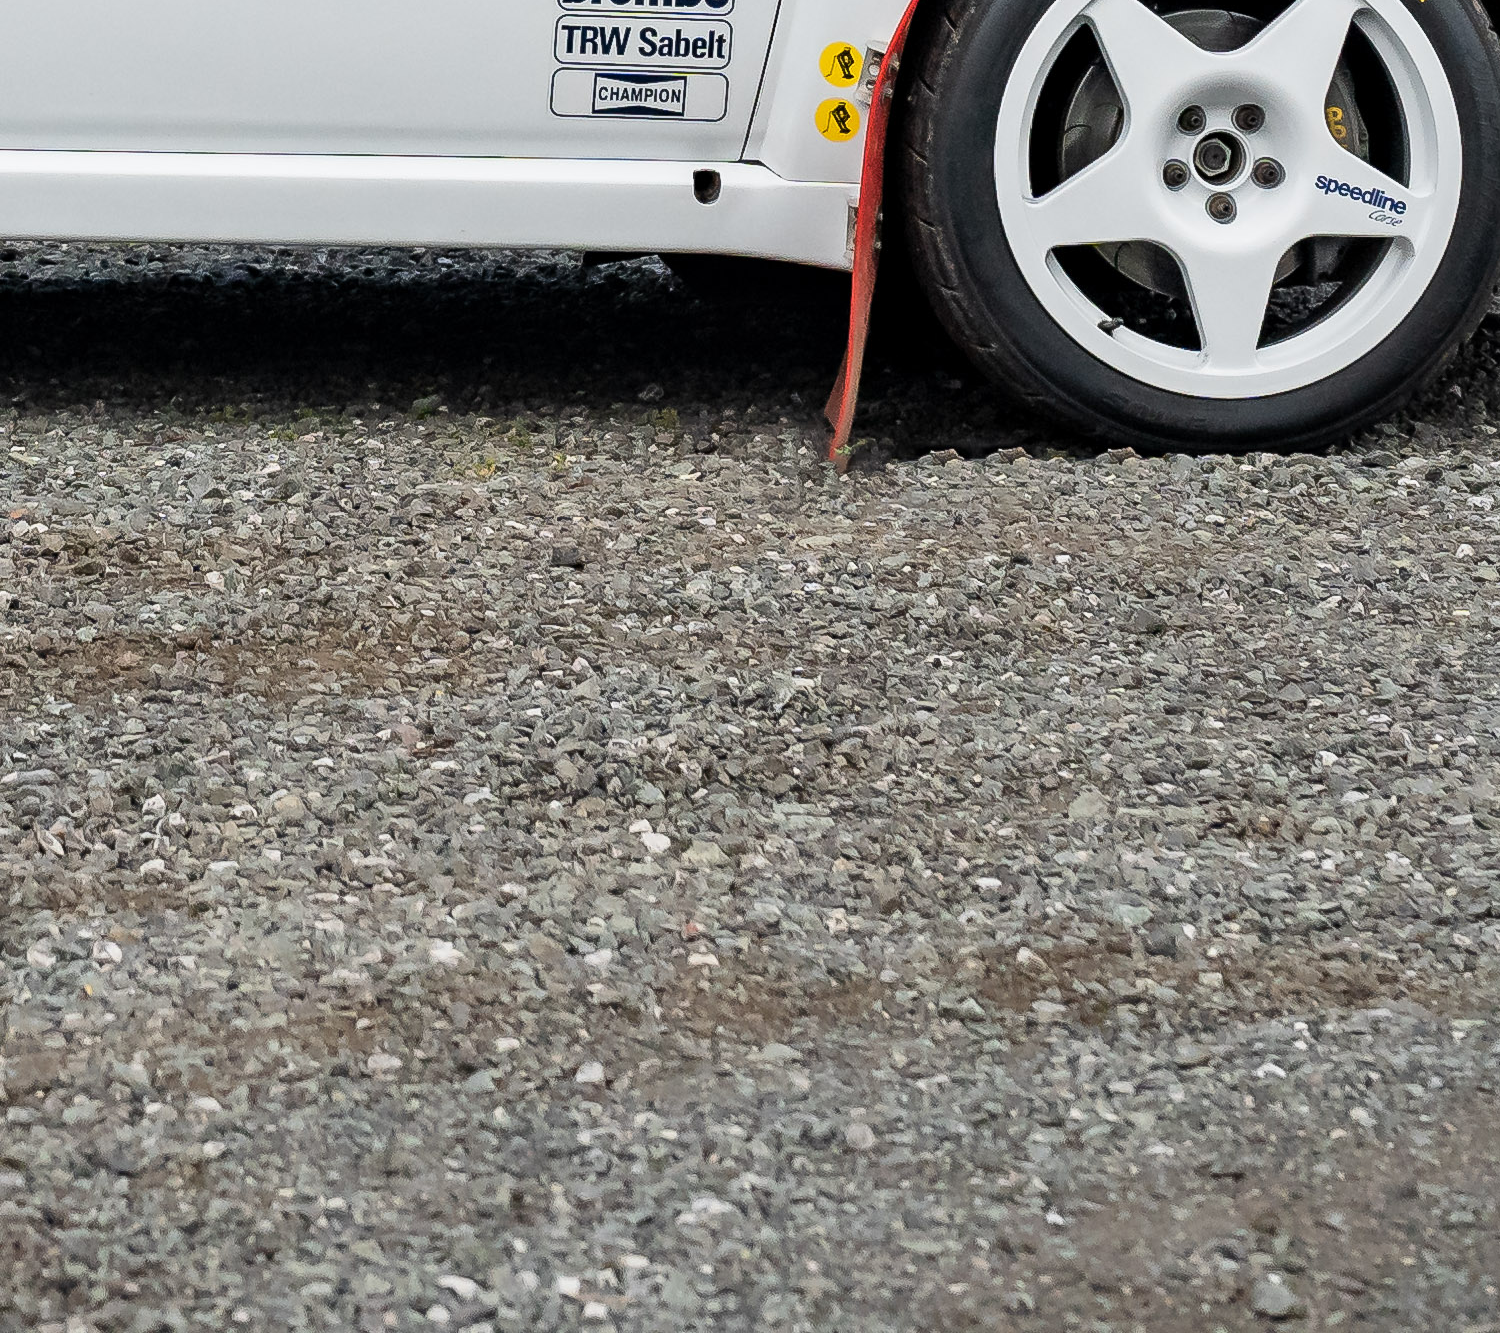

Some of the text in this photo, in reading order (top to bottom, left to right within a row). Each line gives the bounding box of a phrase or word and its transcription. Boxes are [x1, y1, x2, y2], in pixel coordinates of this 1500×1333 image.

[562, 25, 727, 60] TRW Sabelt
[599, 86, 682, 103] CHAMPION
[1315, 175, 1407, 215] speedline
